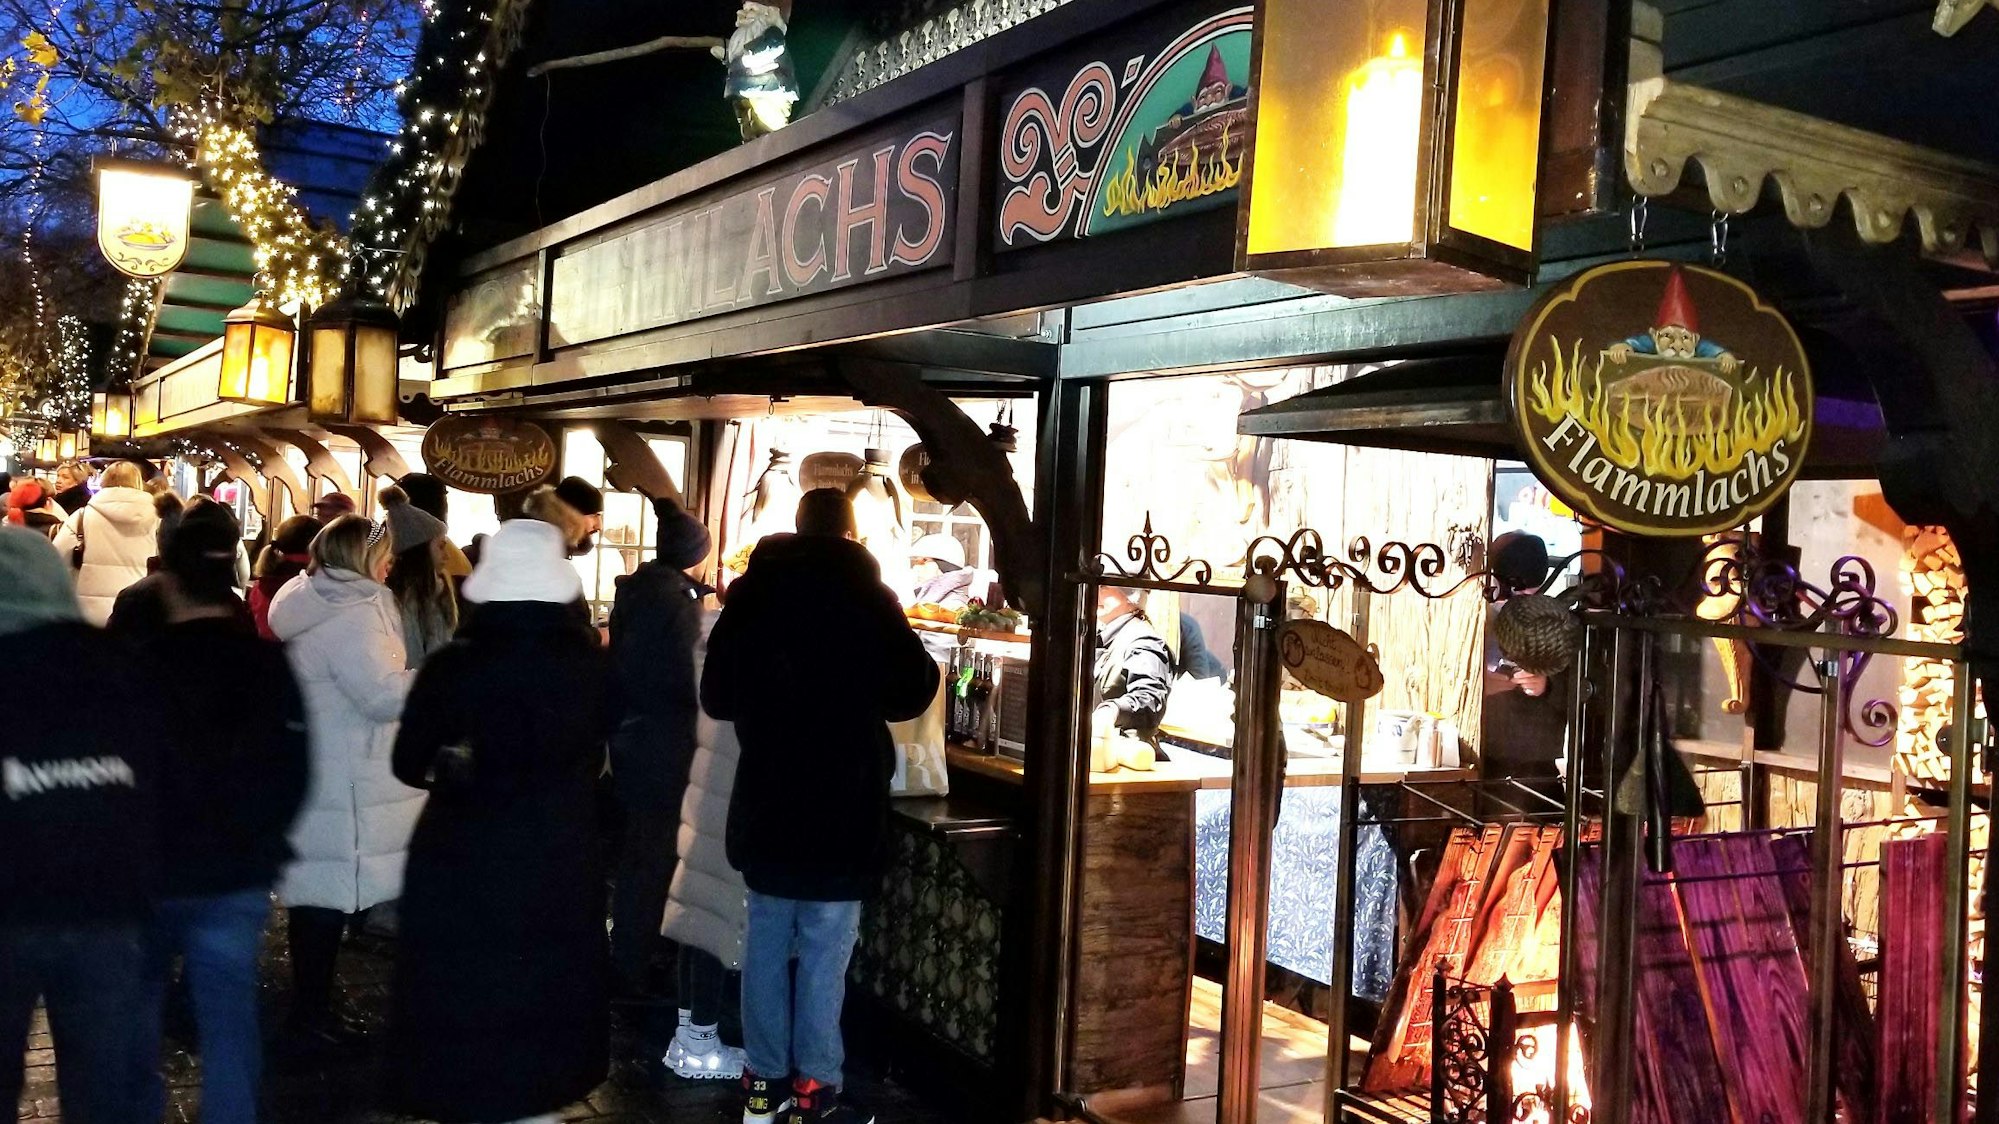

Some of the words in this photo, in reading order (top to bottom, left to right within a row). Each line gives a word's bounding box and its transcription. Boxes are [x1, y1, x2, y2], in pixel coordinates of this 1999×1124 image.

[434, 458, 544, 489] Flammlachs
[1543, 415, 1789, 518] Flammlachs
[754, 1081, 767, 1091] 33
